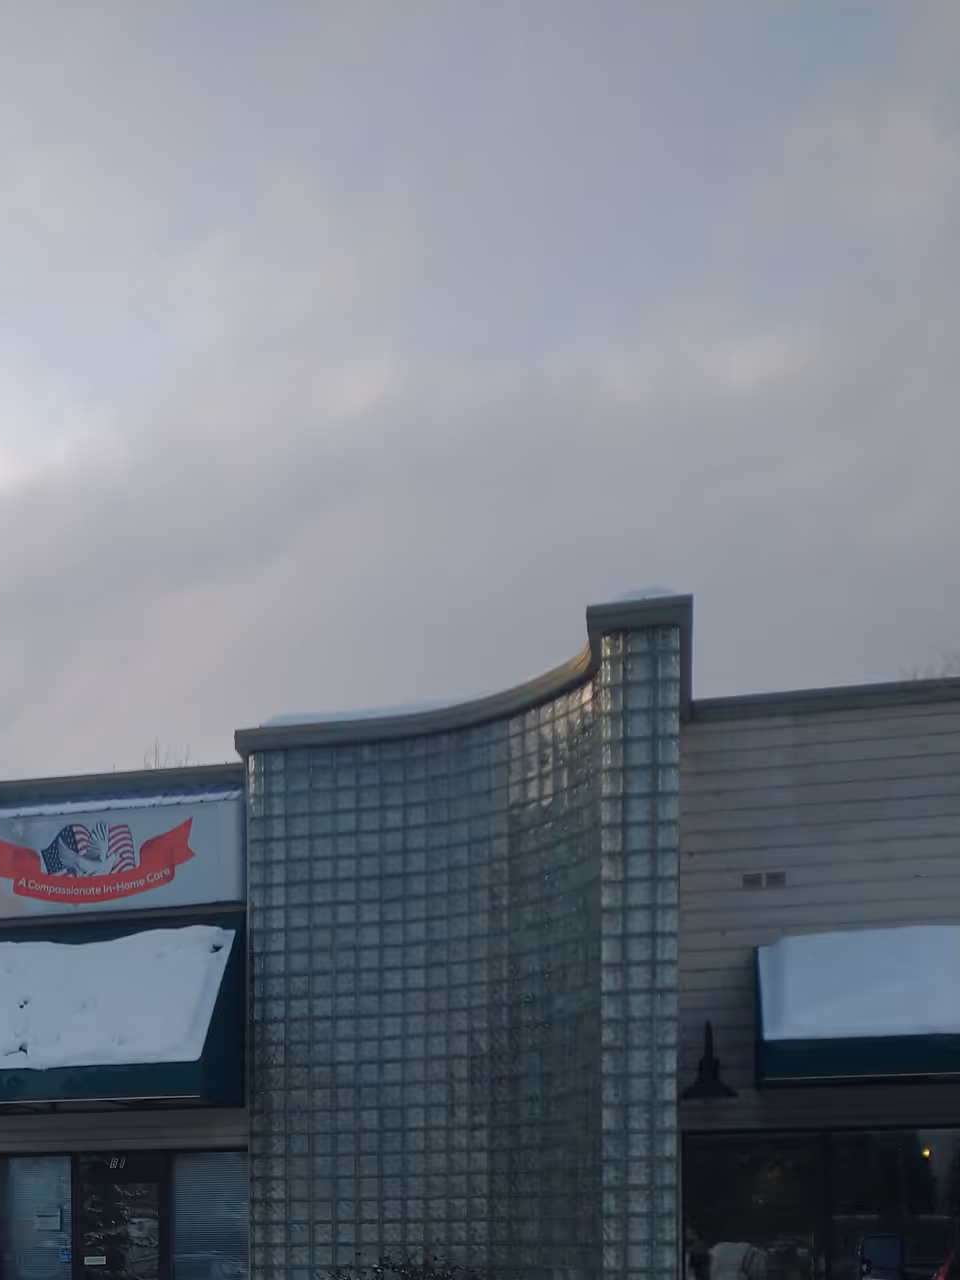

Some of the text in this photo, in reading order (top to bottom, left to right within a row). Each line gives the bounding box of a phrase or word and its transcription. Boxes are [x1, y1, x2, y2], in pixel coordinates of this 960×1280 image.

[19, 868, 170, 895] A Compassionate In-Home Care
